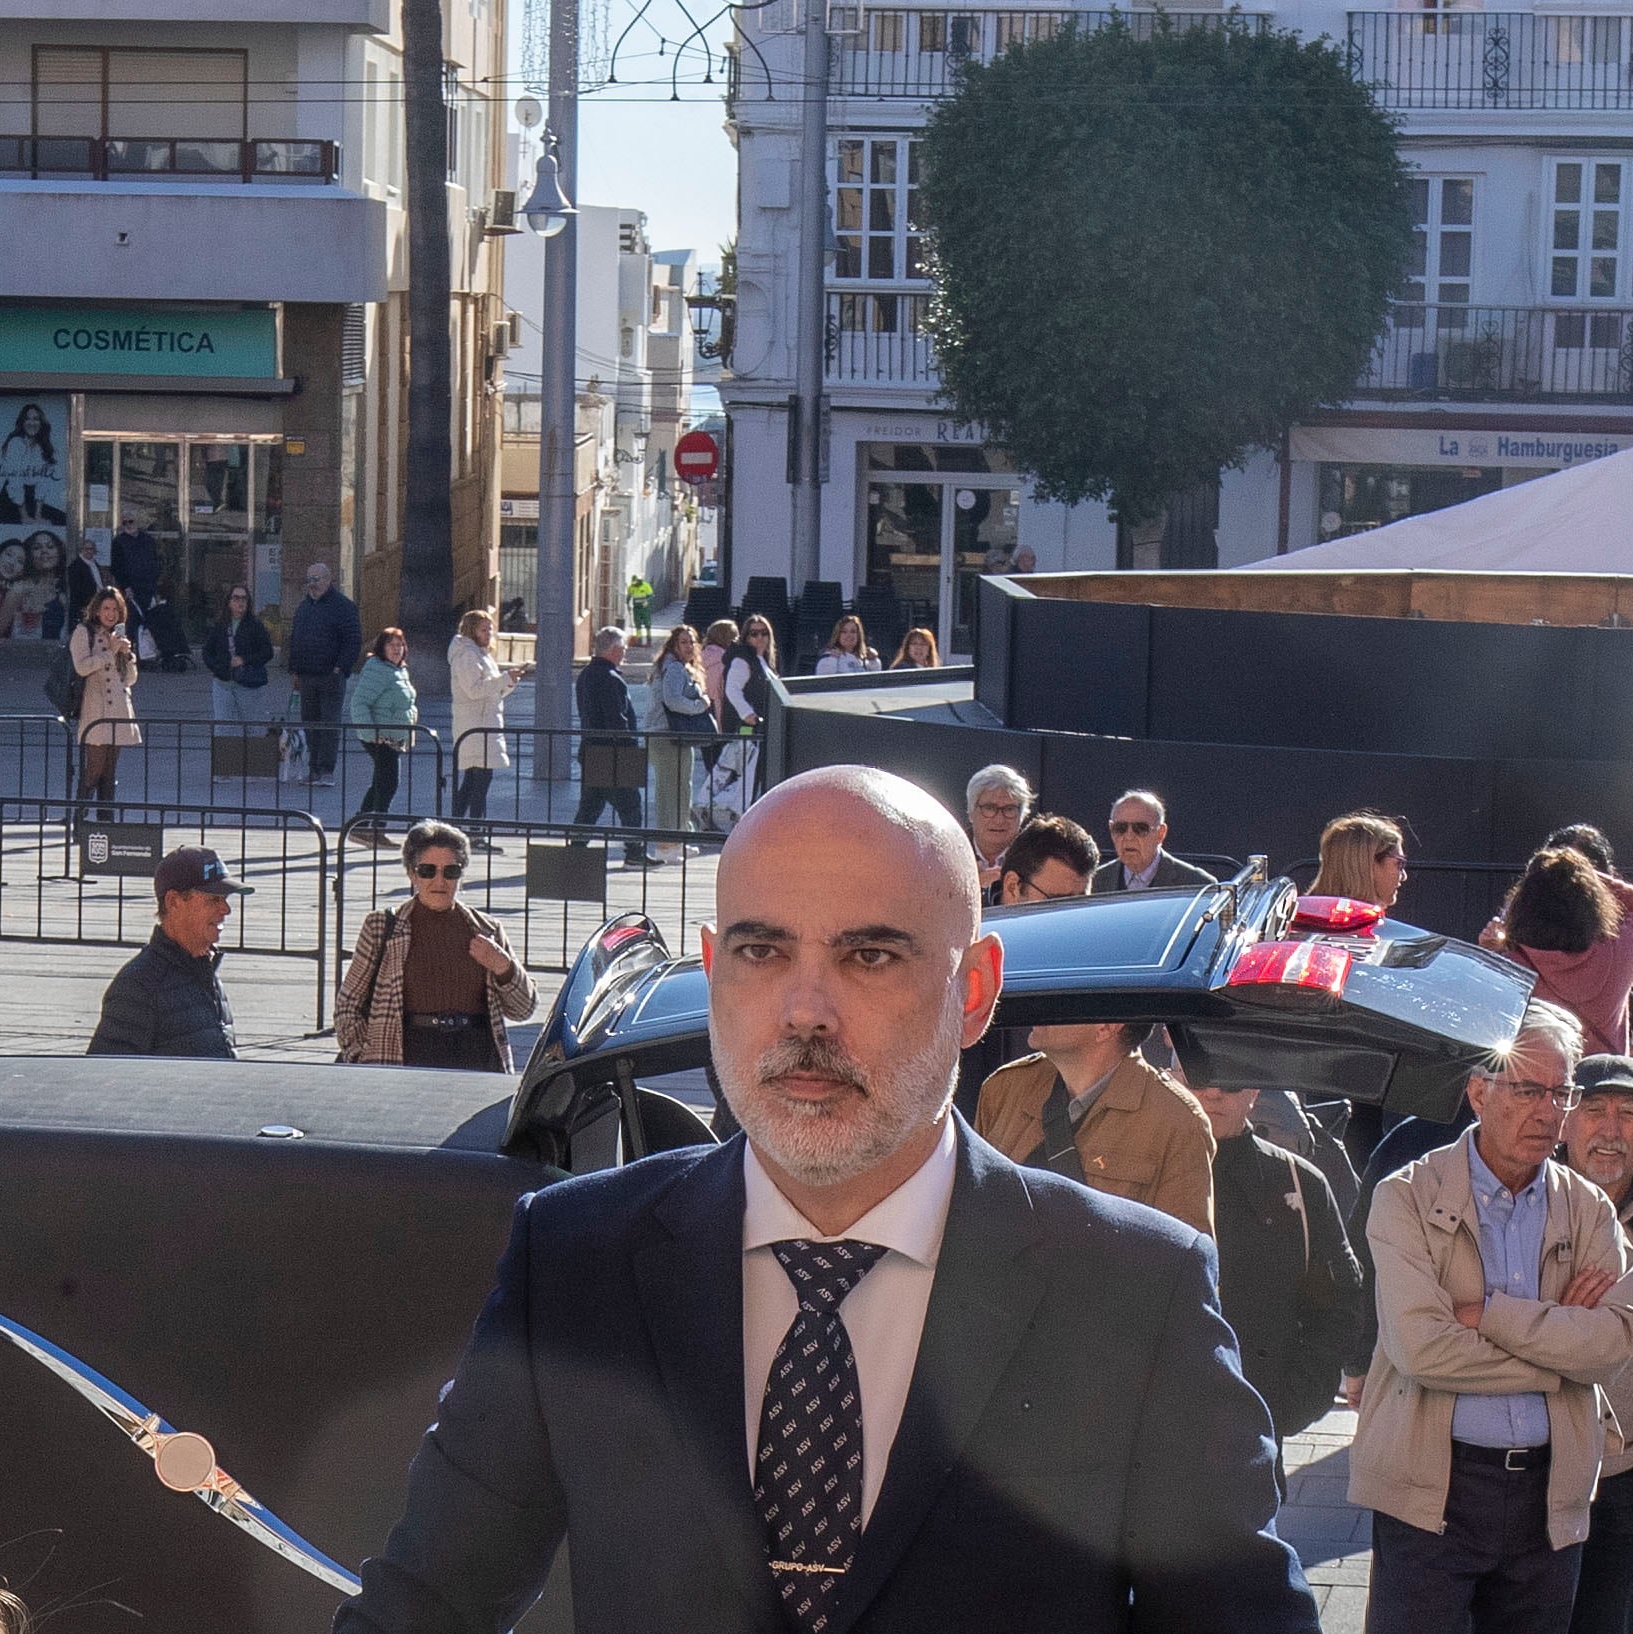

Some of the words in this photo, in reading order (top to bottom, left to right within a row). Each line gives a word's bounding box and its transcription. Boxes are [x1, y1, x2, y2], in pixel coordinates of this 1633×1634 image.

[53, 326, 215, 354] COSMÉTICA
[1439, 435, 1459, 456] La
[834, 1246, 853, 1259] ASV
[812, 1256, 833, 1269] ASV
[794, 1268, 813, 1281] ASV
[816, 1288, 835, 1302] ASV
[794, 1321, 806, 1338] ASV
[803, 1339, 819, 1356] ASV
[780, 1360, 794, 1379] ASV
[816, 1355, 830, 1374] ASV
[791, 1377, 806, 1397] ASV
[828, 1373, 840, 1392] ASV
[806, 1396, 821, 1415] ASV
[840, 1390, 855, 1410] ASV
[768, 1401, 783, 1420] ASV
[782, 1419, 797, 1439] ASV
[819, 1414, 834, 1433] ASV
[796, 1437, 812, 1456] ASV
[833, 1432, 847, 1451] ASV
[759, 1442, 774, 1462] ASV
[846, 1451, 861, 1470] ASV
[773, 1461, 788, 1480] ASV
[810, 1456, 826, 1475] ASV
[787, 1479, 803, 1498] ASV
[824, 1474, 839, 1494] ASV
[801, 1497, 816, 1517] ASV
[836, 1493, 851, 1512] ASV
[765, 1504, 780, 1522] ASV
[779, 1521, 793, 1541] ASV
[814, 1516, 828, 1536] ASV
[791, 1540, 806, 1560] ASV
[827, 1535, 843, 1555] ASV
[771, 1560, 804, 1572] GRUPO
[781, 1582, 796, 1599] ASV
[820, 1576, 835, 1593] ASV
[797, 1597, 812, 1616] ASV
[812, 1614, 828, 1634] ASV
